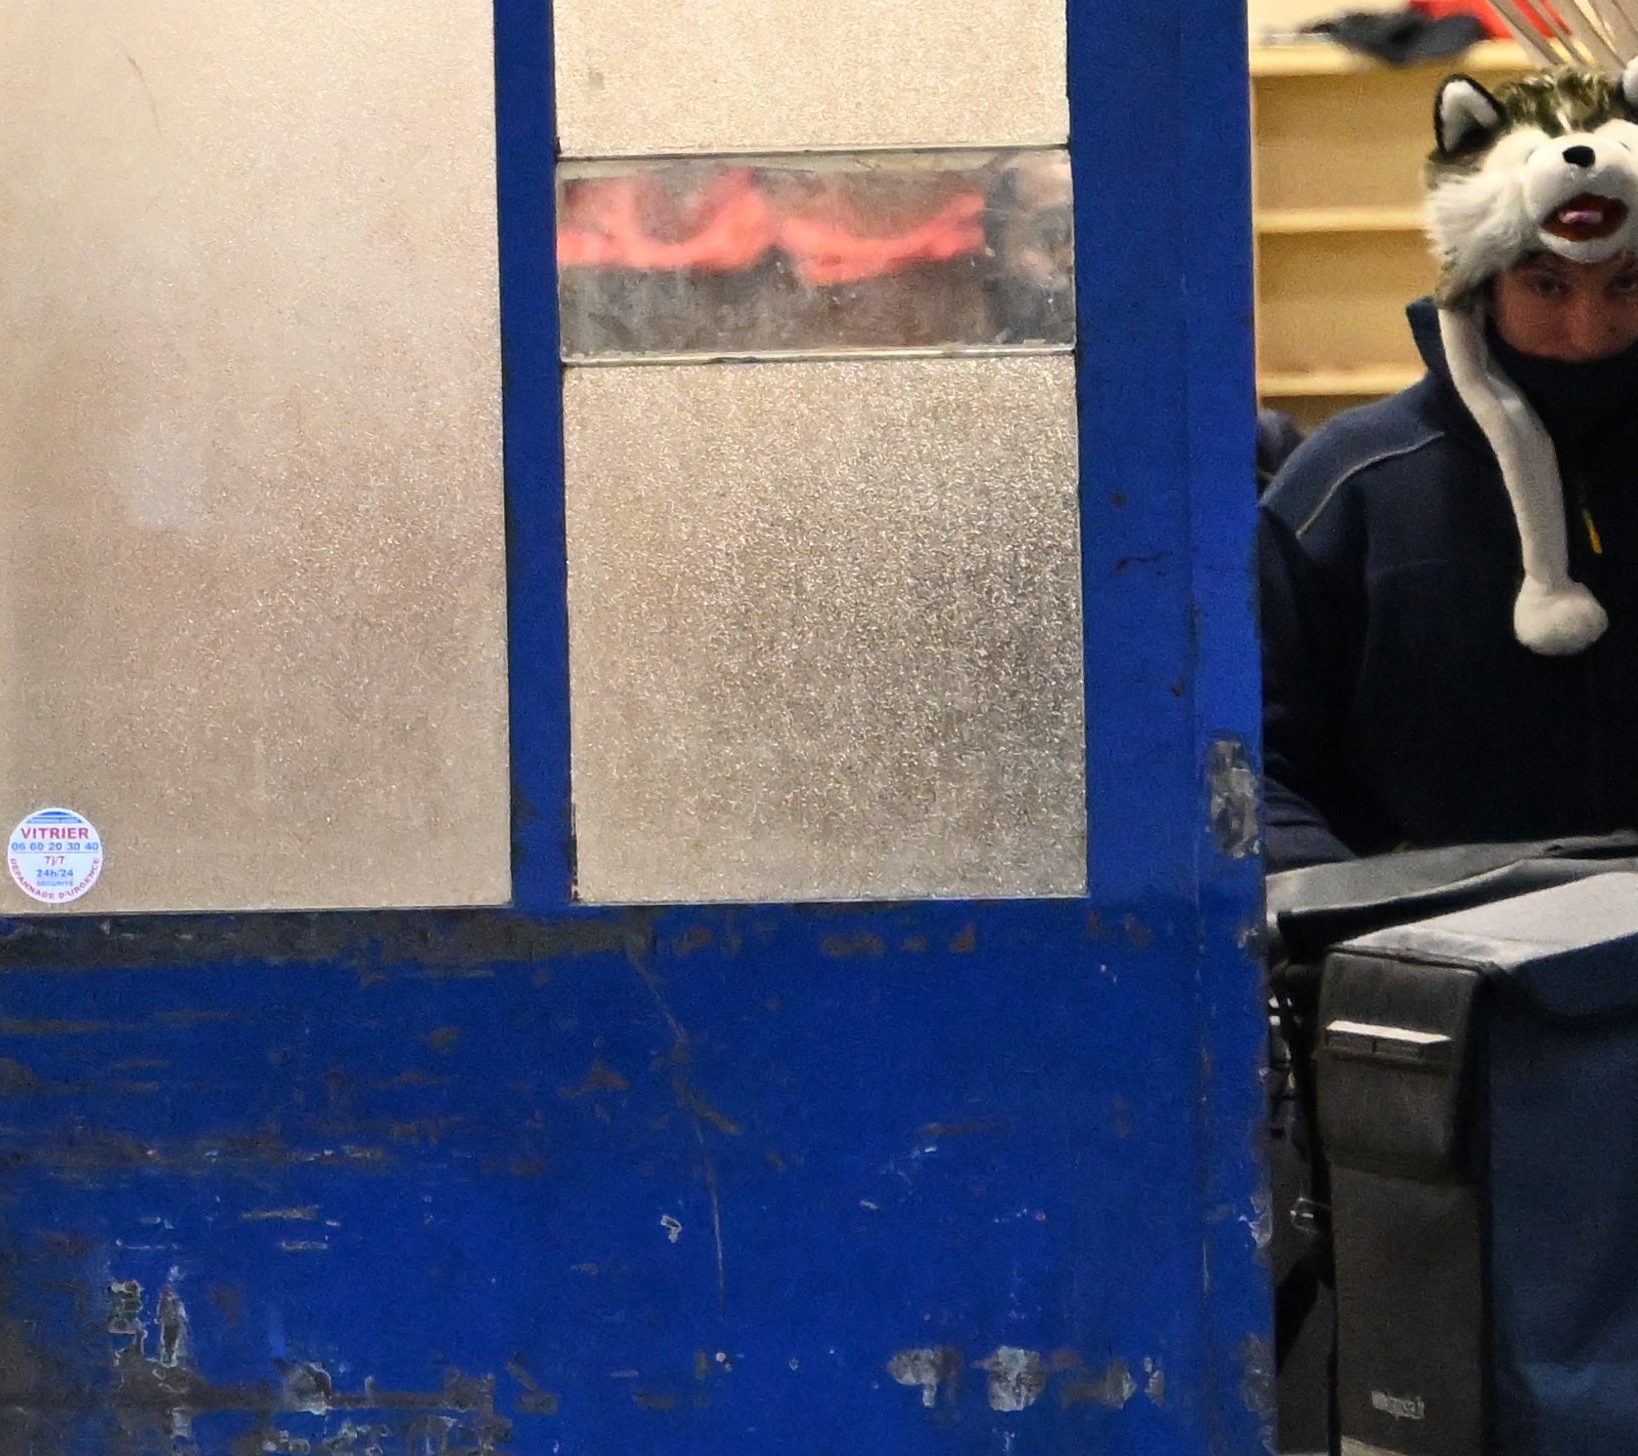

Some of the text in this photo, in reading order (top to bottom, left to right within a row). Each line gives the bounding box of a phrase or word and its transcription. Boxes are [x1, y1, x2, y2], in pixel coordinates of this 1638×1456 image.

[20, 827, 89, 840] VITRIER
[11, 842, 99, 851] 06 60 20 30 40
[36, 869, 74, 877] 24h/24
